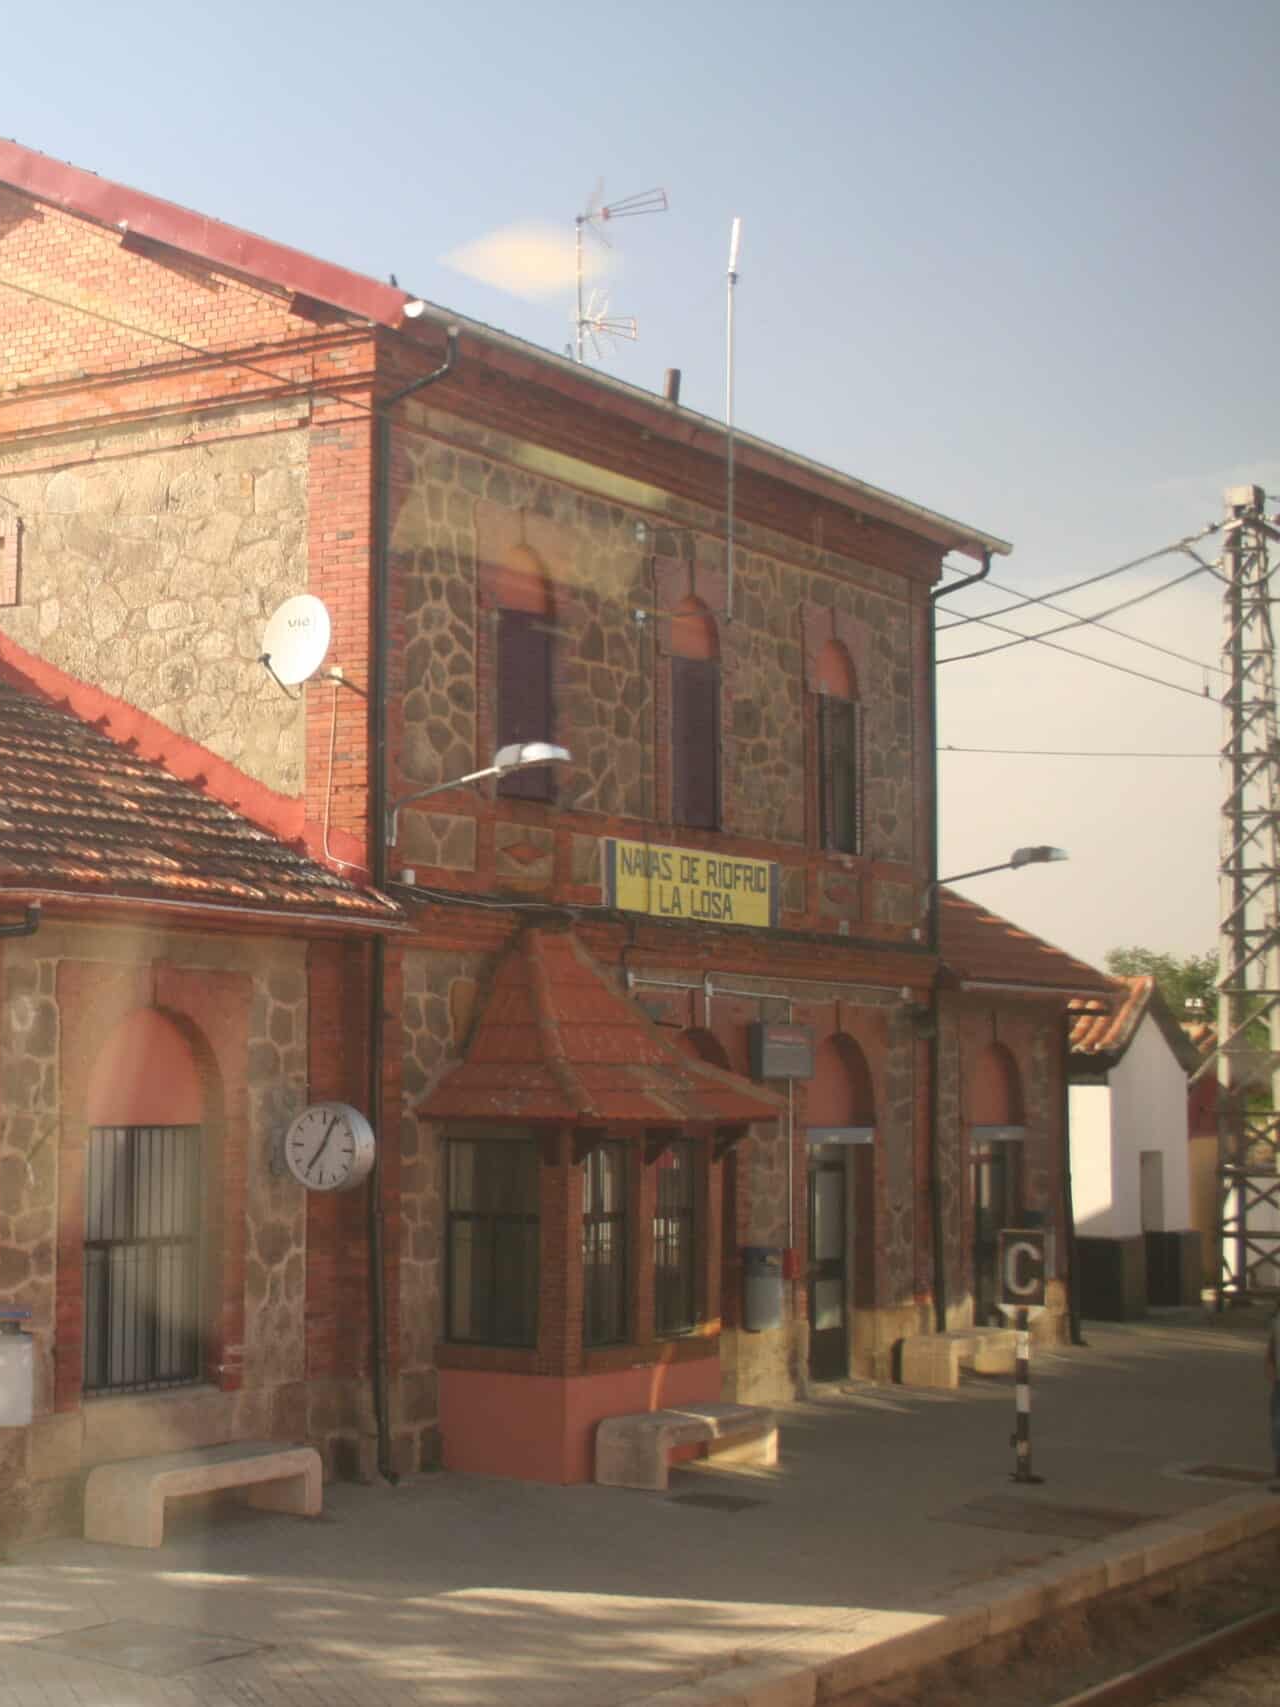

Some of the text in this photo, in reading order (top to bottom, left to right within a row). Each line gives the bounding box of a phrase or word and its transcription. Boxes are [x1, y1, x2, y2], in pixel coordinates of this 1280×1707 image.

[620, 847, 767, 893] NAVAS DE RIOFRIO
[658, 884, 734, 920] LA LOSA
[1006, 1241, 1041, 1295] C
